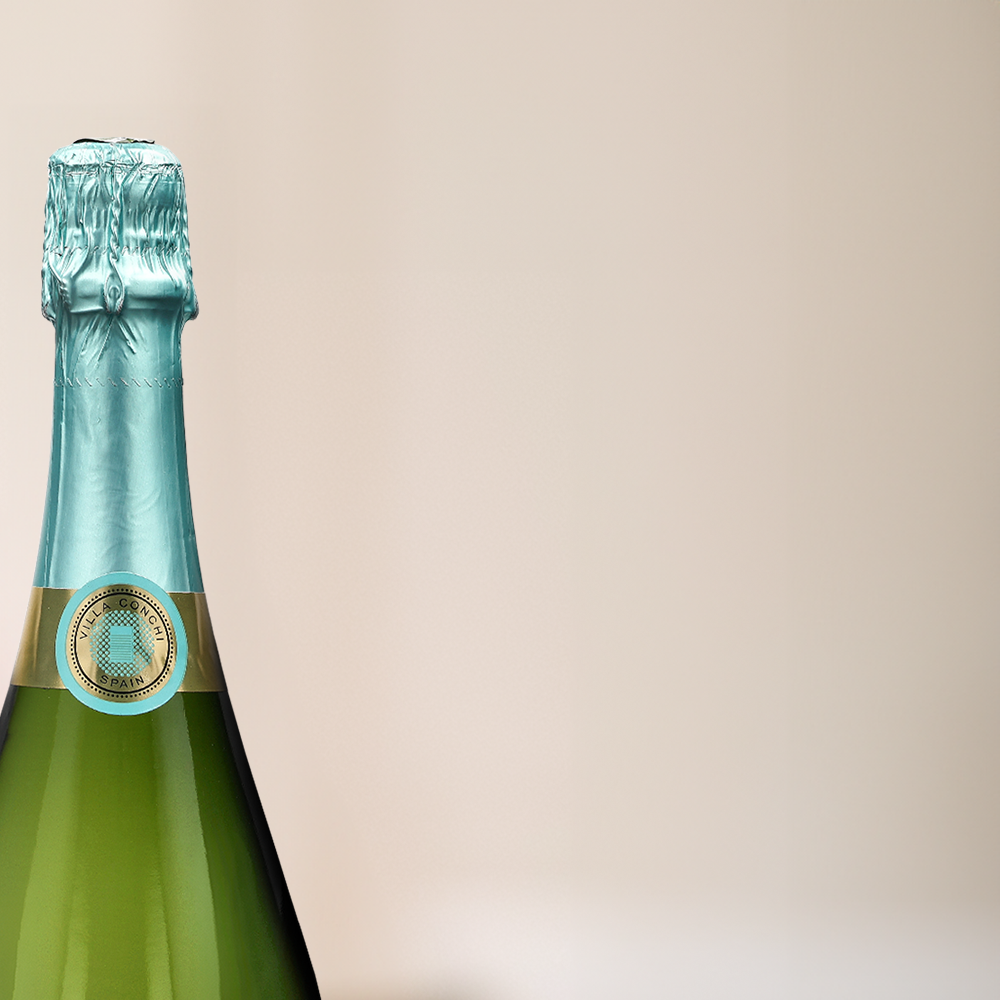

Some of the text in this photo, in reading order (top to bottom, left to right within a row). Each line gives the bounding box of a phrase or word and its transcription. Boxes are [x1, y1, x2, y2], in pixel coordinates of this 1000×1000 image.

[79, 598, 164, 641] VILLA CONCHI
[99, 674, 145, 688] SPAIN
